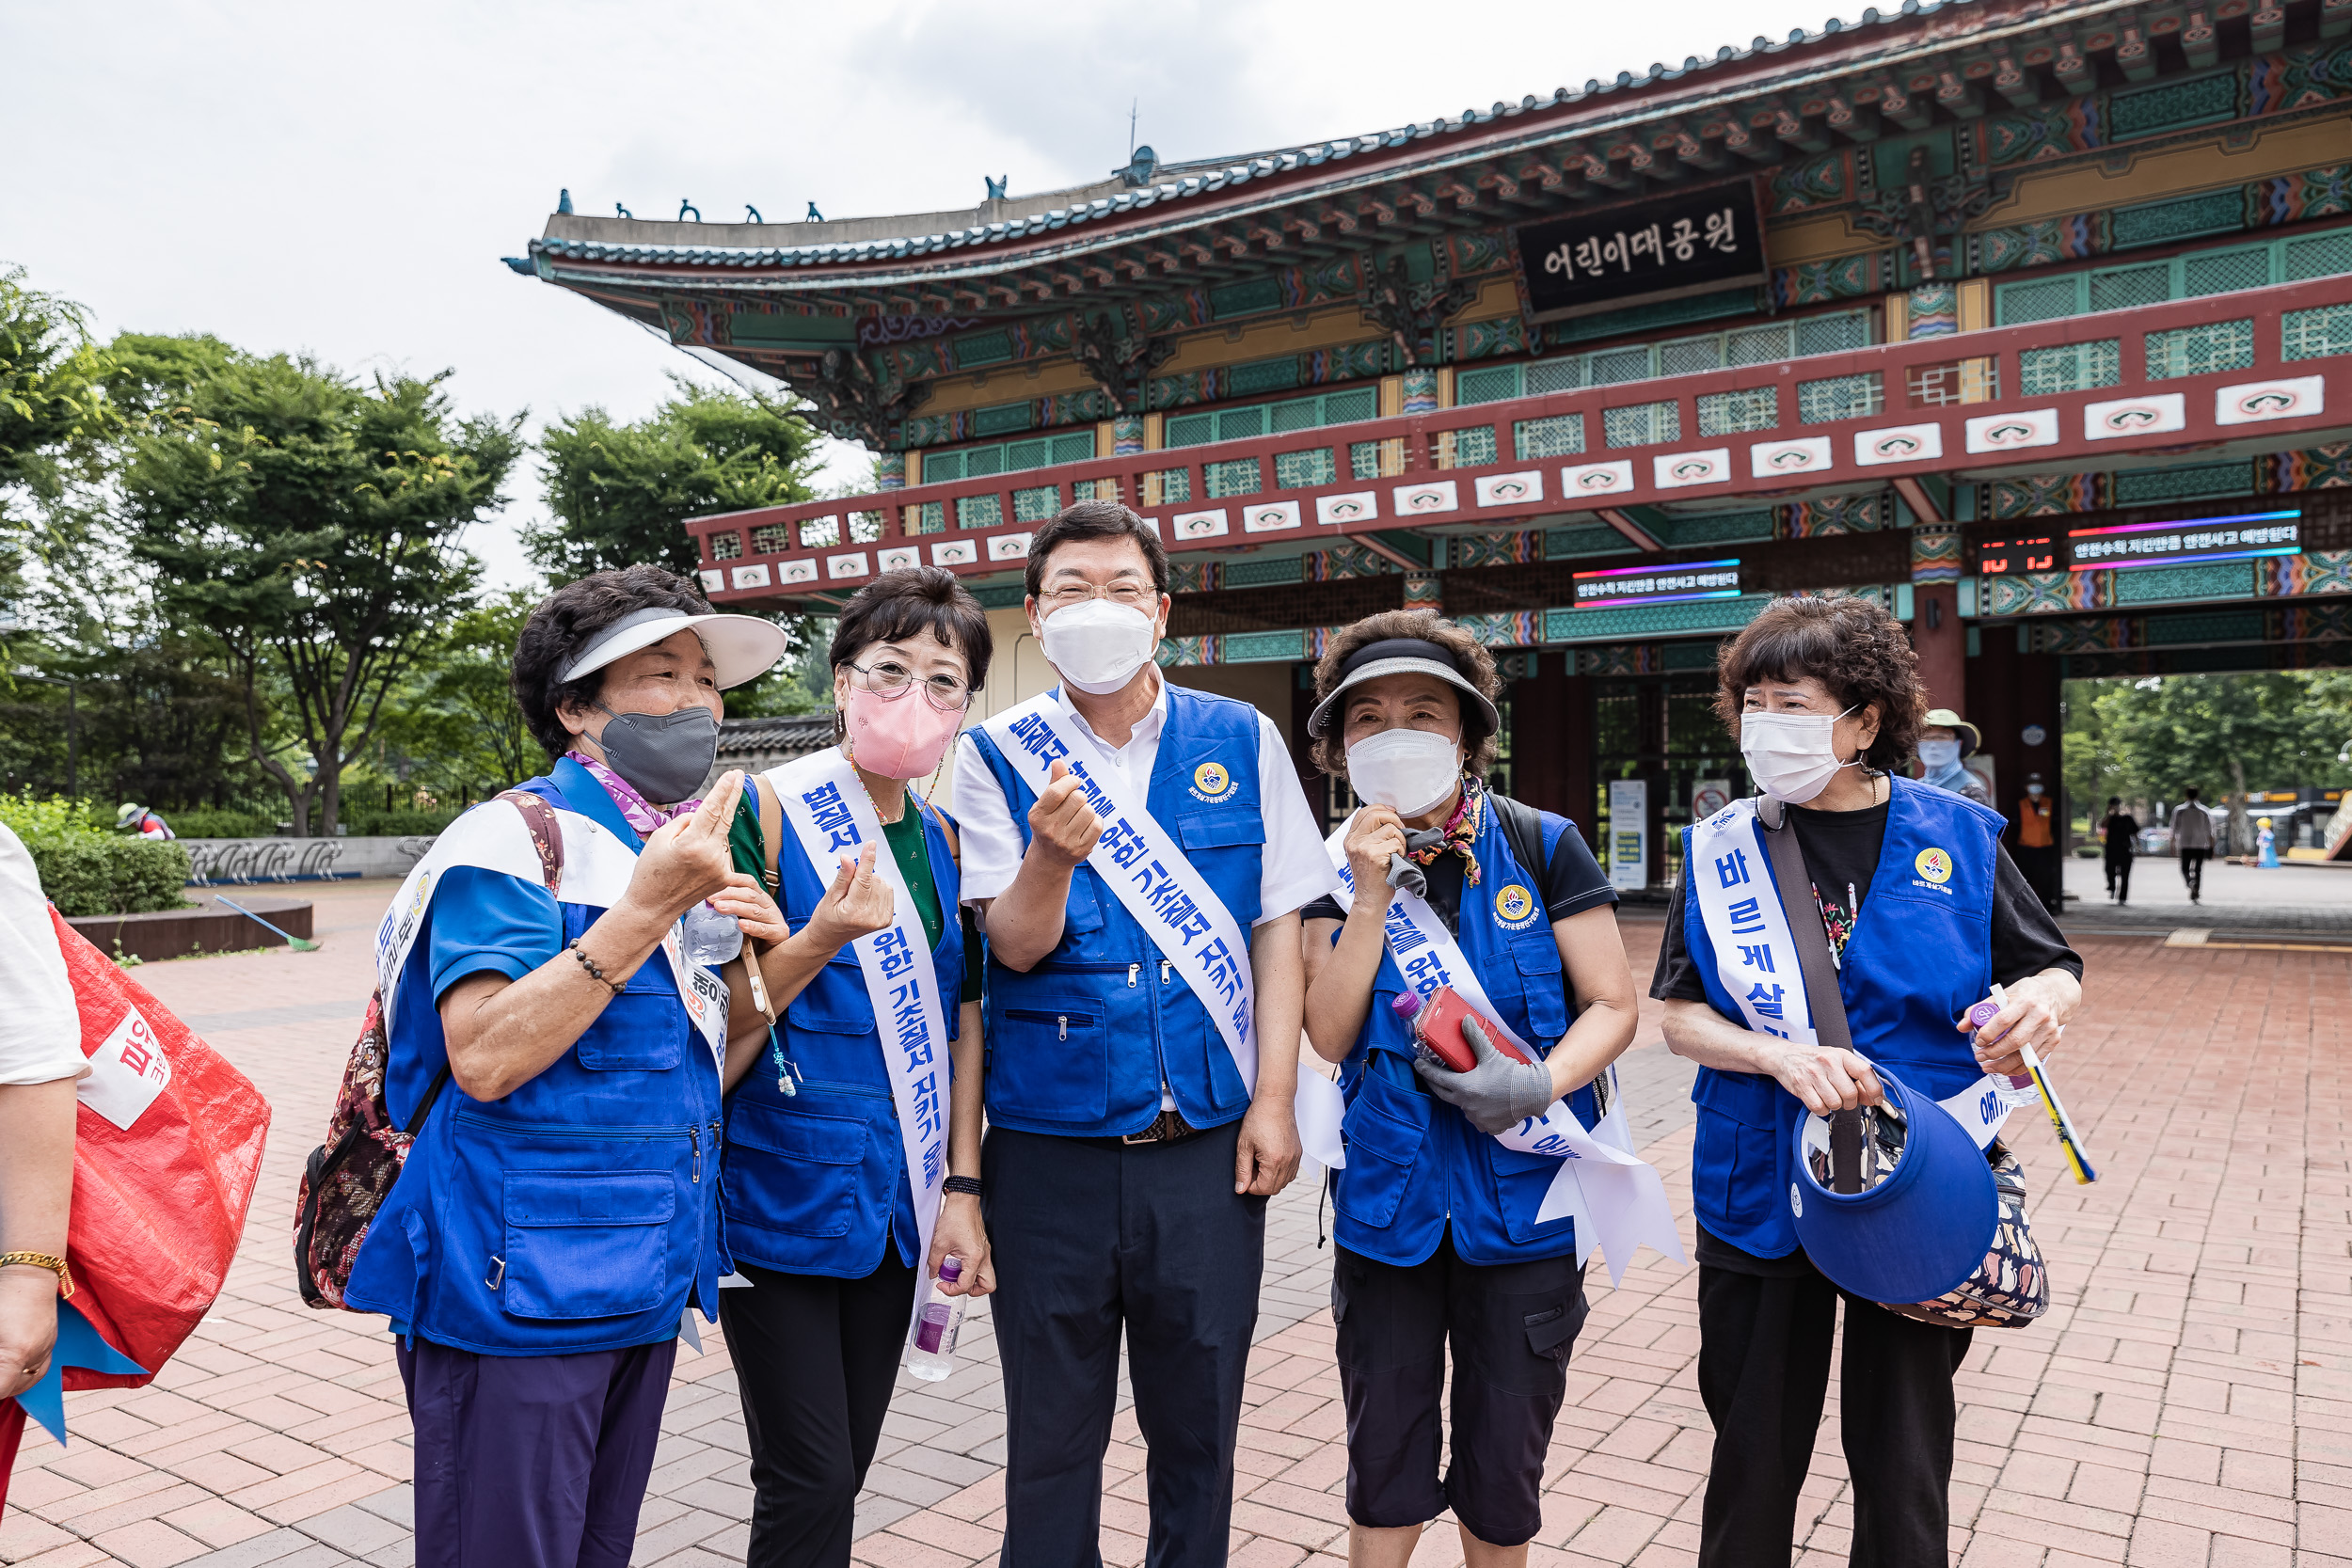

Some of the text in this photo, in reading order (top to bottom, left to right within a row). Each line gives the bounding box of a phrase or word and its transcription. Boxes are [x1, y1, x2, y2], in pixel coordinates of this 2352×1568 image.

[1544, 207, 1739, 281] 어린이대공원
[2183, 531, 2239, 549] 안전사고
[802, 781, 863, 853] 법질서
[1009, 712, 1069, 772] 법질서
[1099, 817, 1150, 871] 위한
[1131, 860, 1213, 946] 기초질서
[1195, 937, 1244, 1006] 지키기
[873, 926, 914, 979] 위한
[890, 986, 933, 1073] 기초질서
[912, 1073, 942, 1144] 지키기
